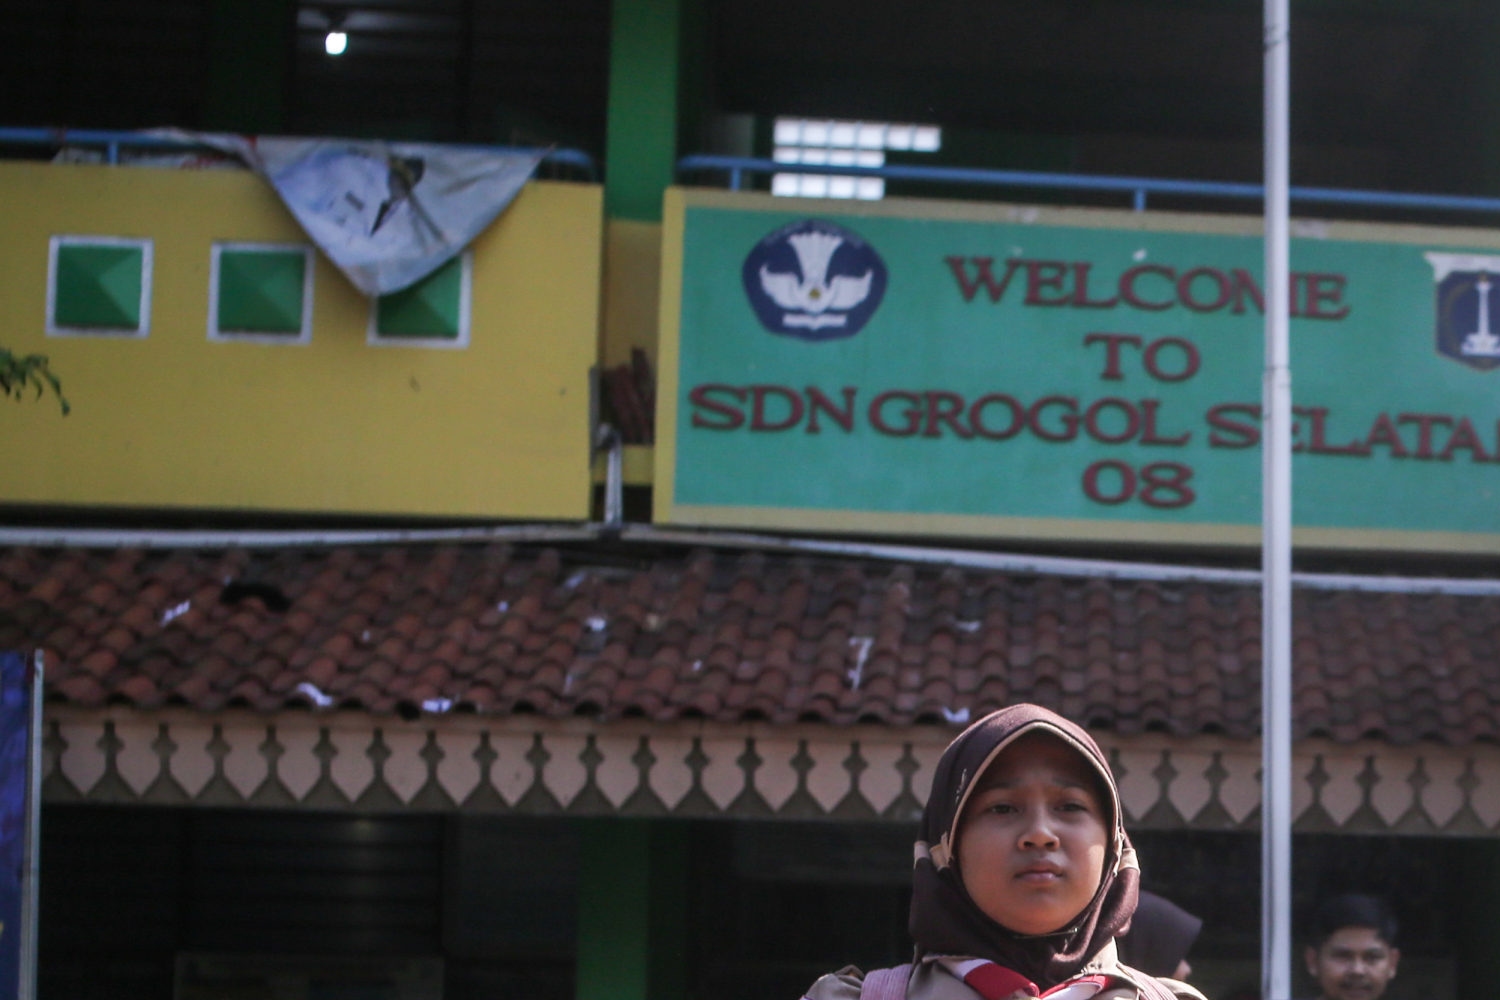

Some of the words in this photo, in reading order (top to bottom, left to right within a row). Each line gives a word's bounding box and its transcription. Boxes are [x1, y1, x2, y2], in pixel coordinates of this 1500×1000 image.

[945, 255, 1350, 320] WELCOME
[1083, 333, 1202, 383] TO
[688, 383, 858, 434] SDN
[868, 390, 1191, 446] GROGOL
[1081, 458, 1196, 509] 08
